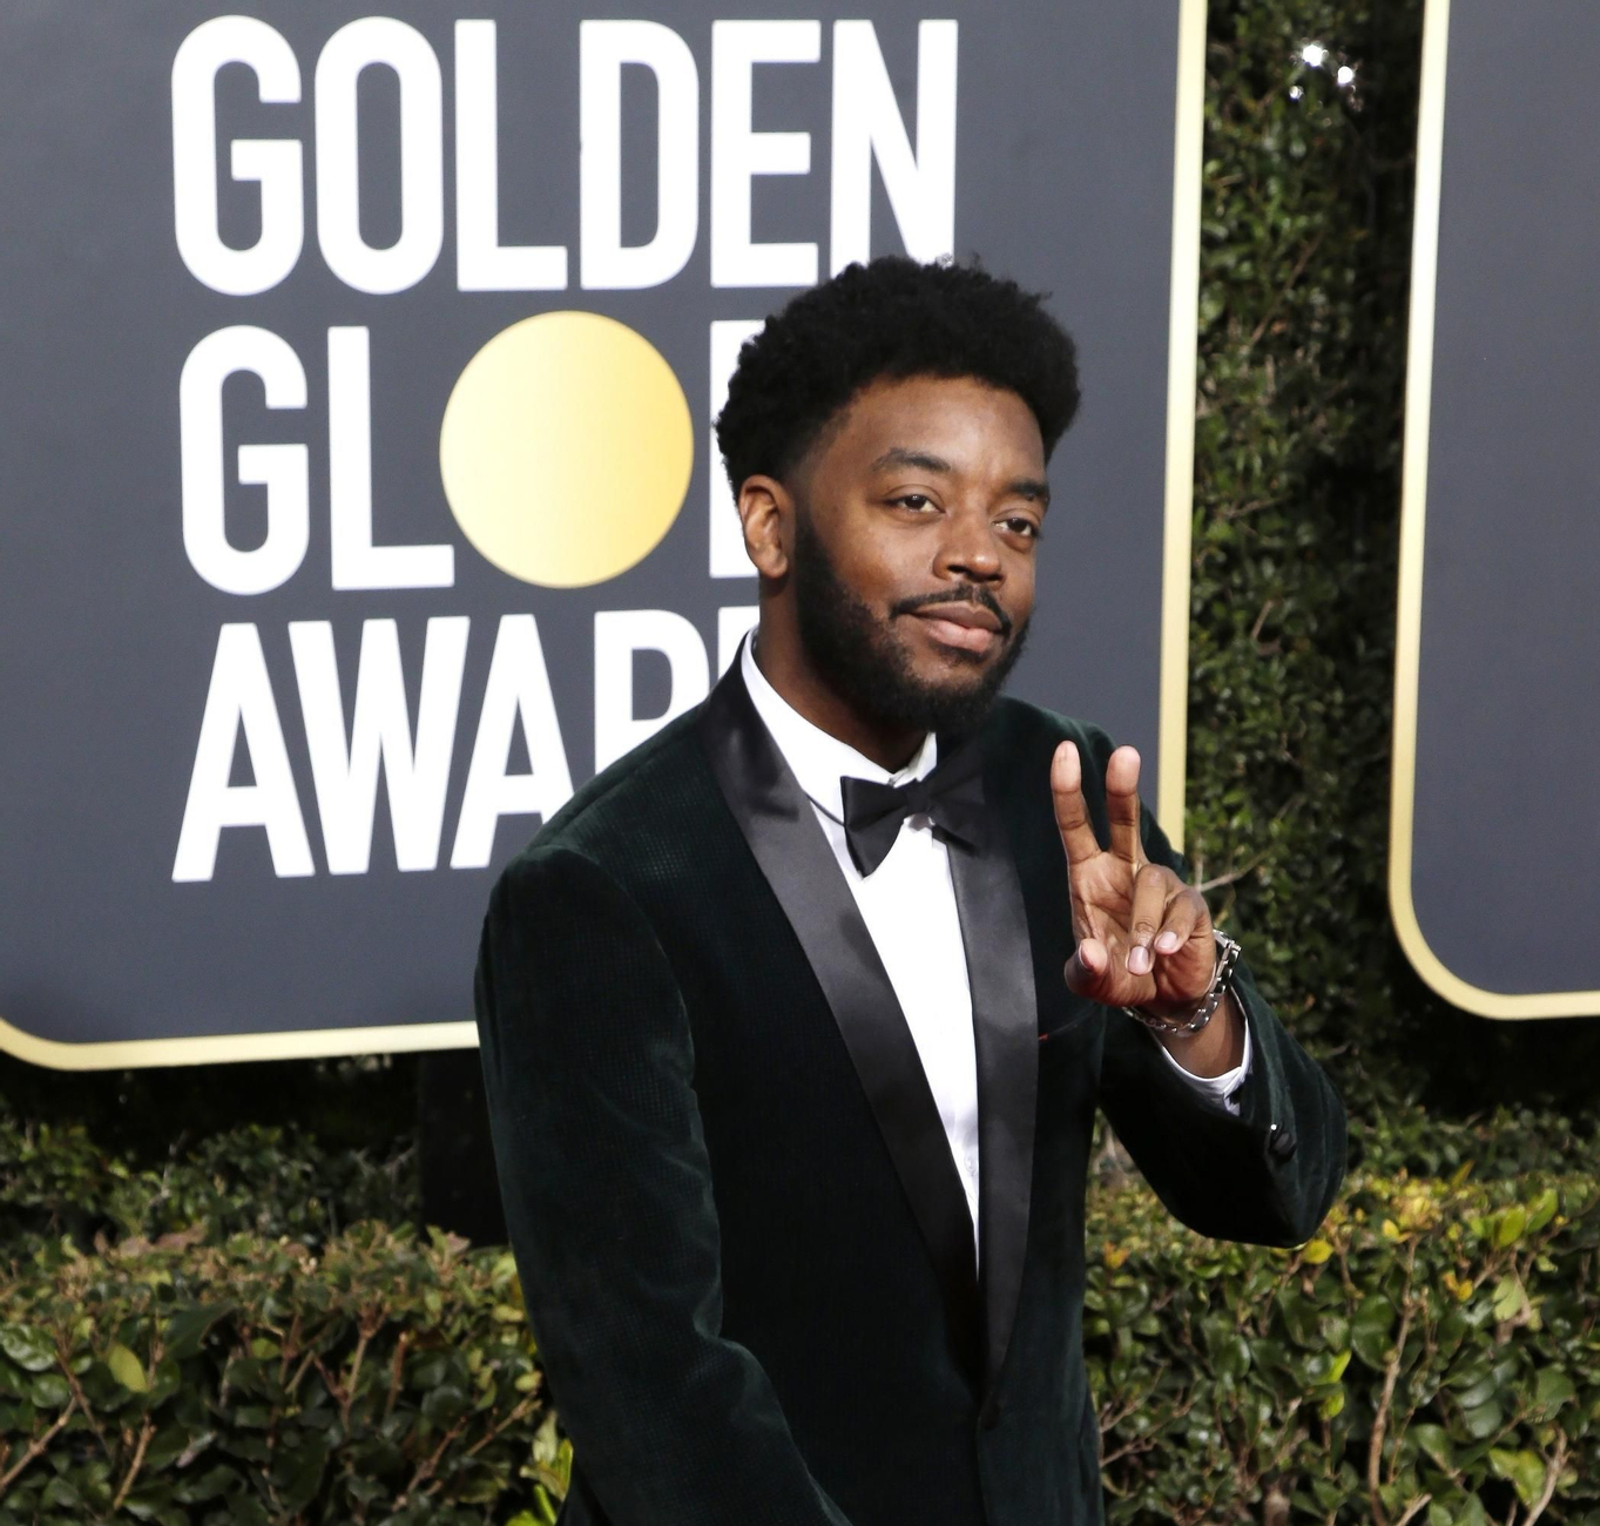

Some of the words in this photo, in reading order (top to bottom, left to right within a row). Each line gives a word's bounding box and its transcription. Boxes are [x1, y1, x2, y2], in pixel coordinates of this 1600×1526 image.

[171, 14, 959, 295] GOLDEN
[179, 310, 765, 596] GLO
[171, 605, 760, 883] AWAR
